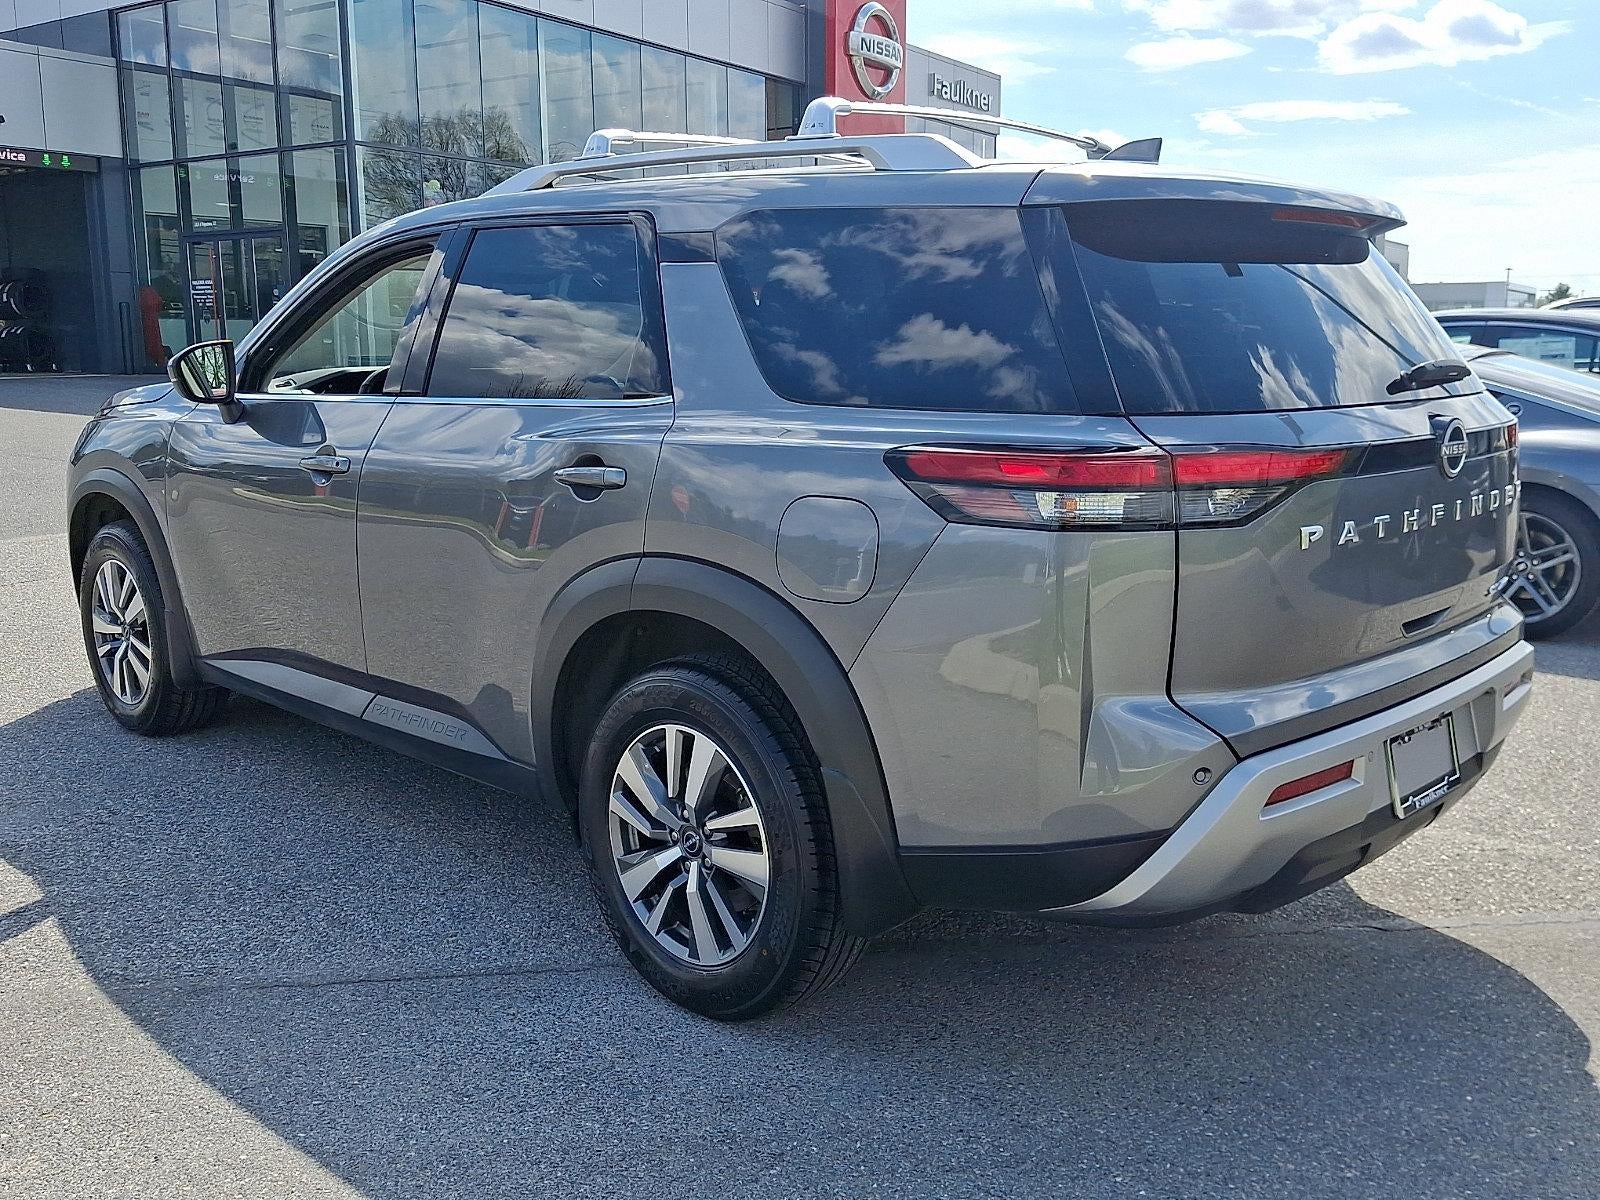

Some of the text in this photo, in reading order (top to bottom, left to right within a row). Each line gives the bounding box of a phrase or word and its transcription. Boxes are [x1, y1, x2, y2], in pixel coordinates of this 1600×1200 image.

[860, 36, 902, 64] NISSAN
[932, 72, 994, 112] Faulkner
[1442, 443, 1466, 456] NISS
[371, 703, 468, 741] PATHFINDER
